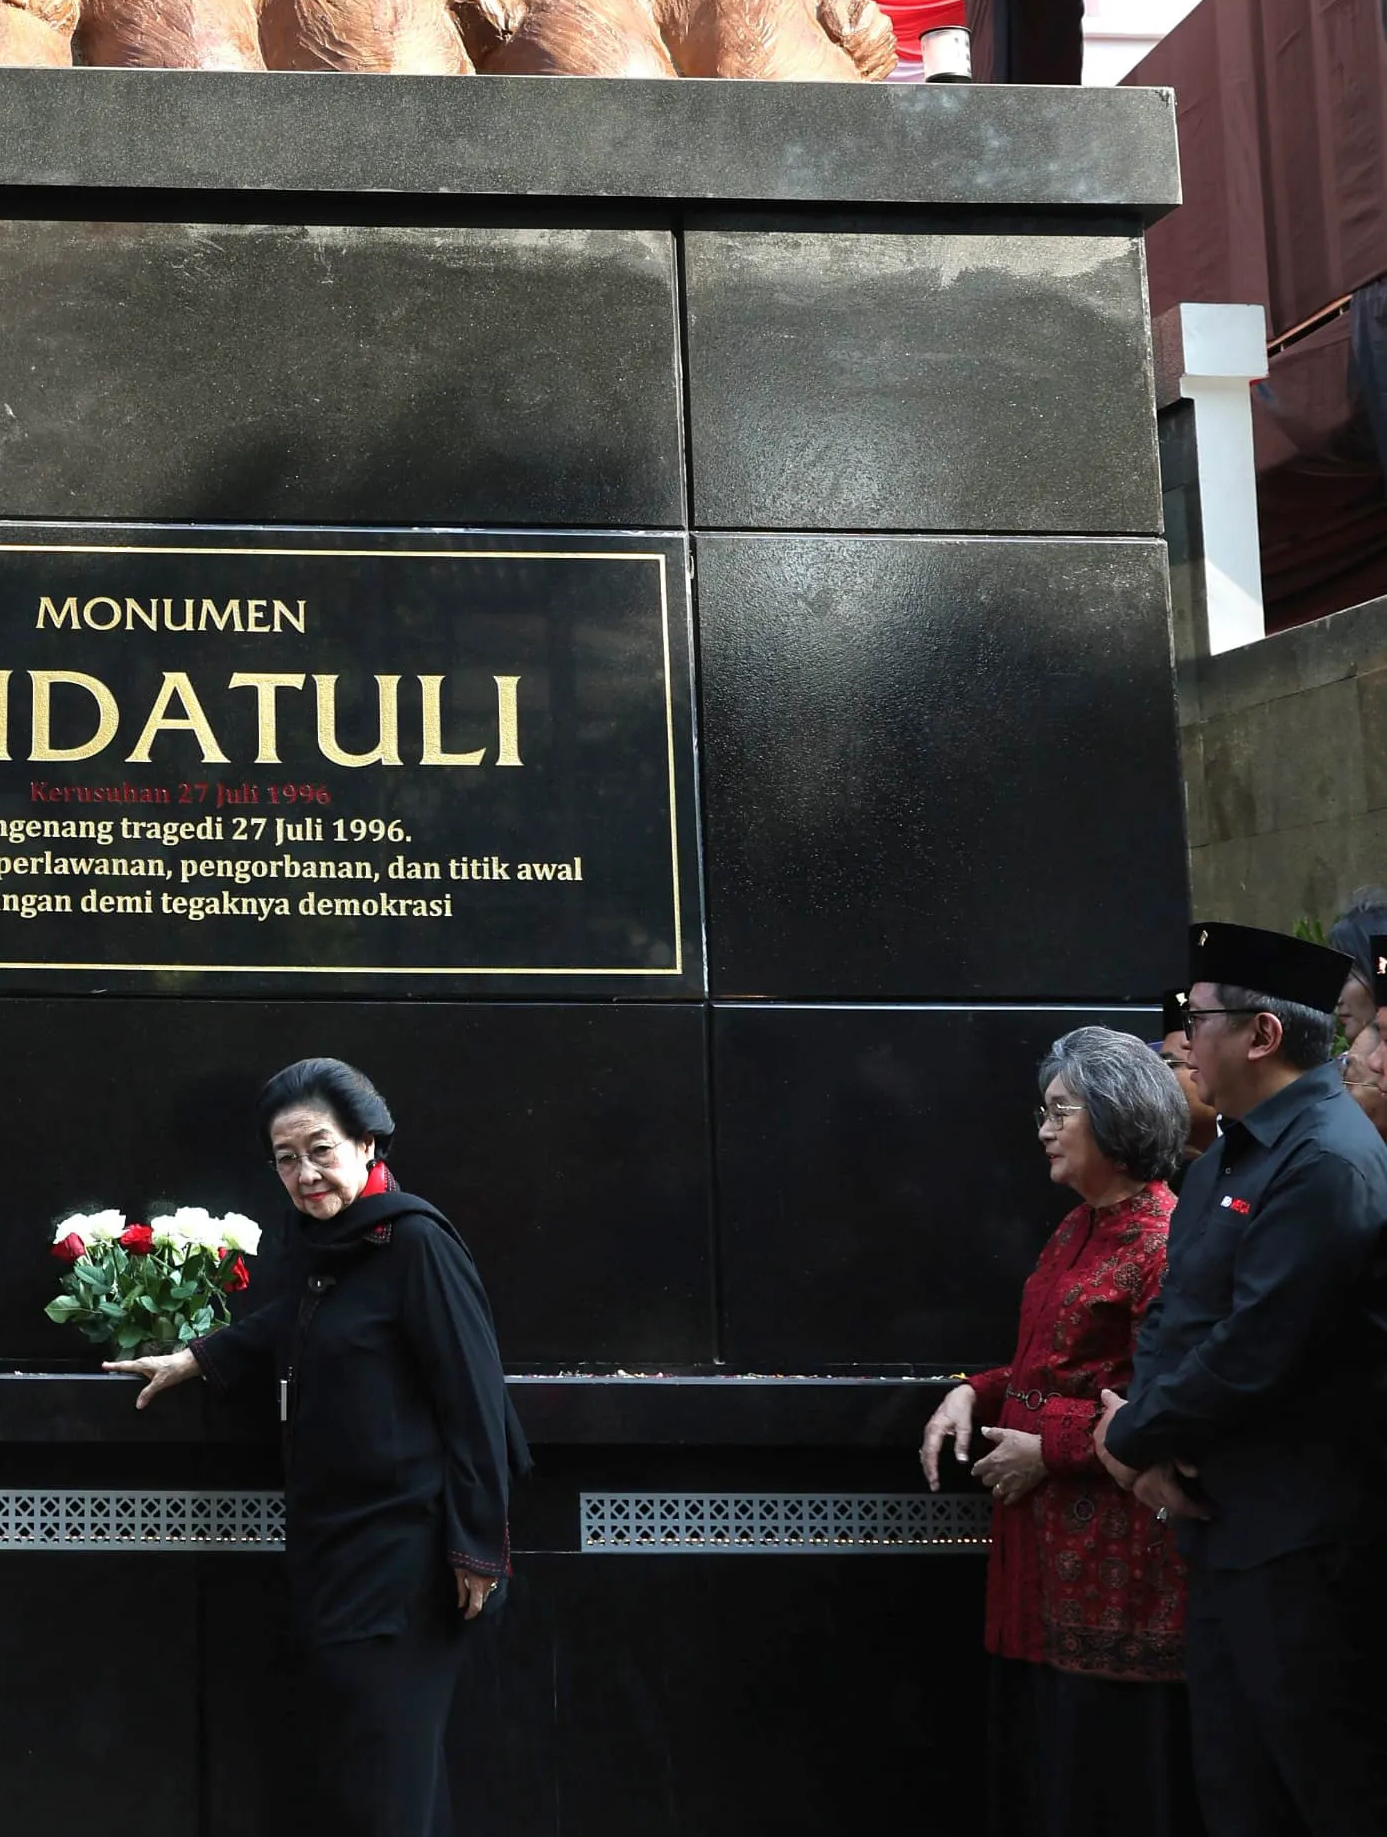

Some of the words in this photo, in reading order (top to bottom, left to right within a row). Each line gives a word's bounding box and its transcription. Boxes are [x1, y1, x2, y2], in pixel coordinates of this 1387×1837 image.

[35, 596, 307, 634] MONUMEN
[29, 780, 170, 804] Kerusuhan
[178, 782, 210, 804] 27
[216, 782, 259, 809] Juli
[268, 783, 332, 805] 1996
[119, 815, 225, 846] tragedi
[231, 817, 268, 841] 27
[275, 817, 324, 847] Juli
[332, 818, 412, 843] 1996.
[180, 853, 380, 884] pengorbanan,
[387, 855, 442, 880] dan
[448, 856, 511, 880] titik
[516, 856, 583, 881] awal
[80, 888, 154, 914] demi
[160, 890, 291, 922] tegaknya
[298, 891, 453, 917] demokrasi
